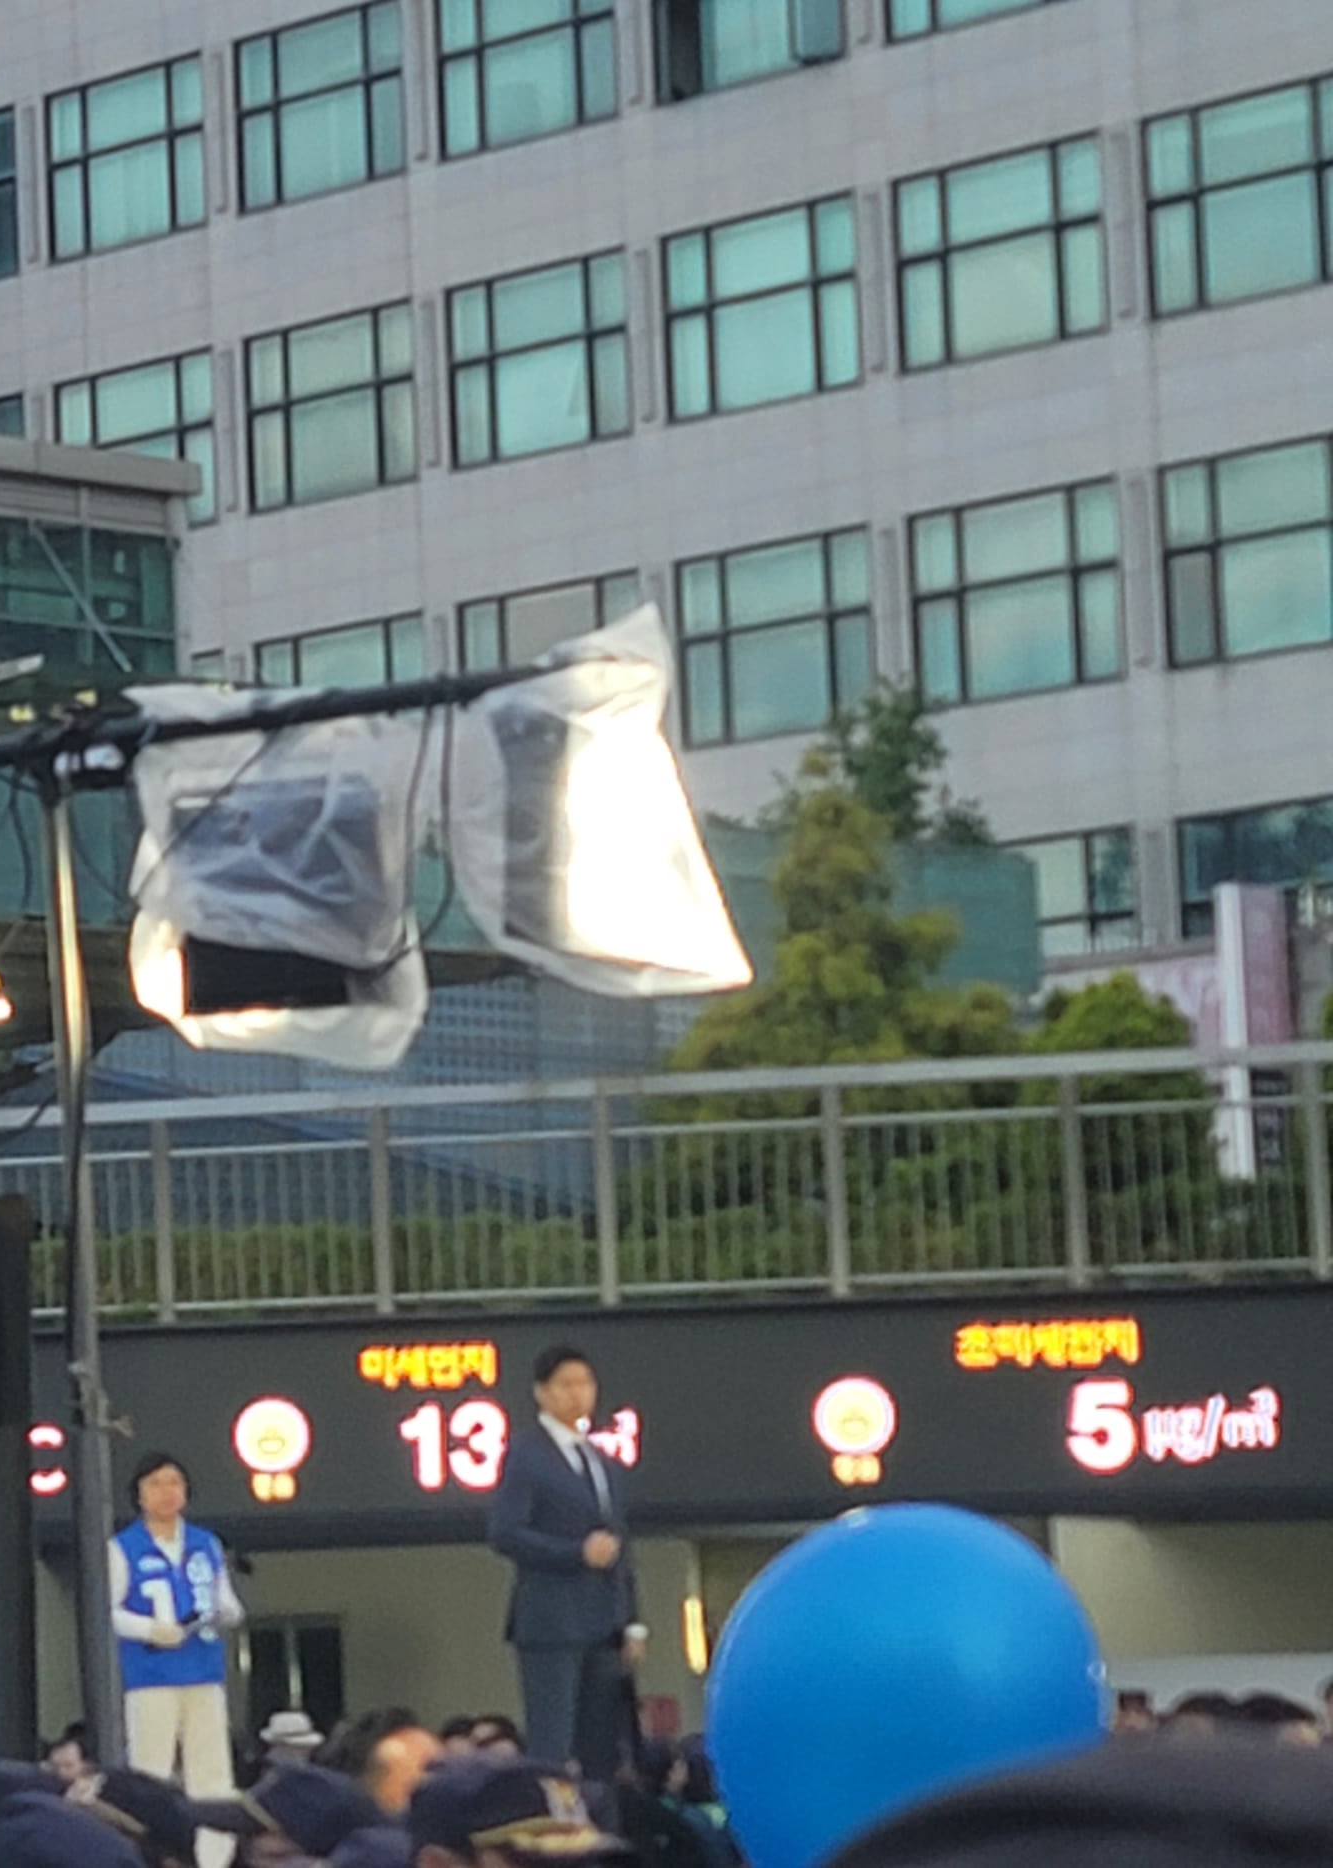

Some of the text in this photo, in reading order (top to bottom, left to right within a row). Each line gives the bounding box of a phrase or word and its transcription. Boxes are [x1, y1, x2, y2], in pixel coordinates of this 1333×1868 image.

[358, 1340, 499, 1389] 미세먼지
[399, 1399, 508, 1490] 13
[1066, 1375, 1138, 1475] 5
